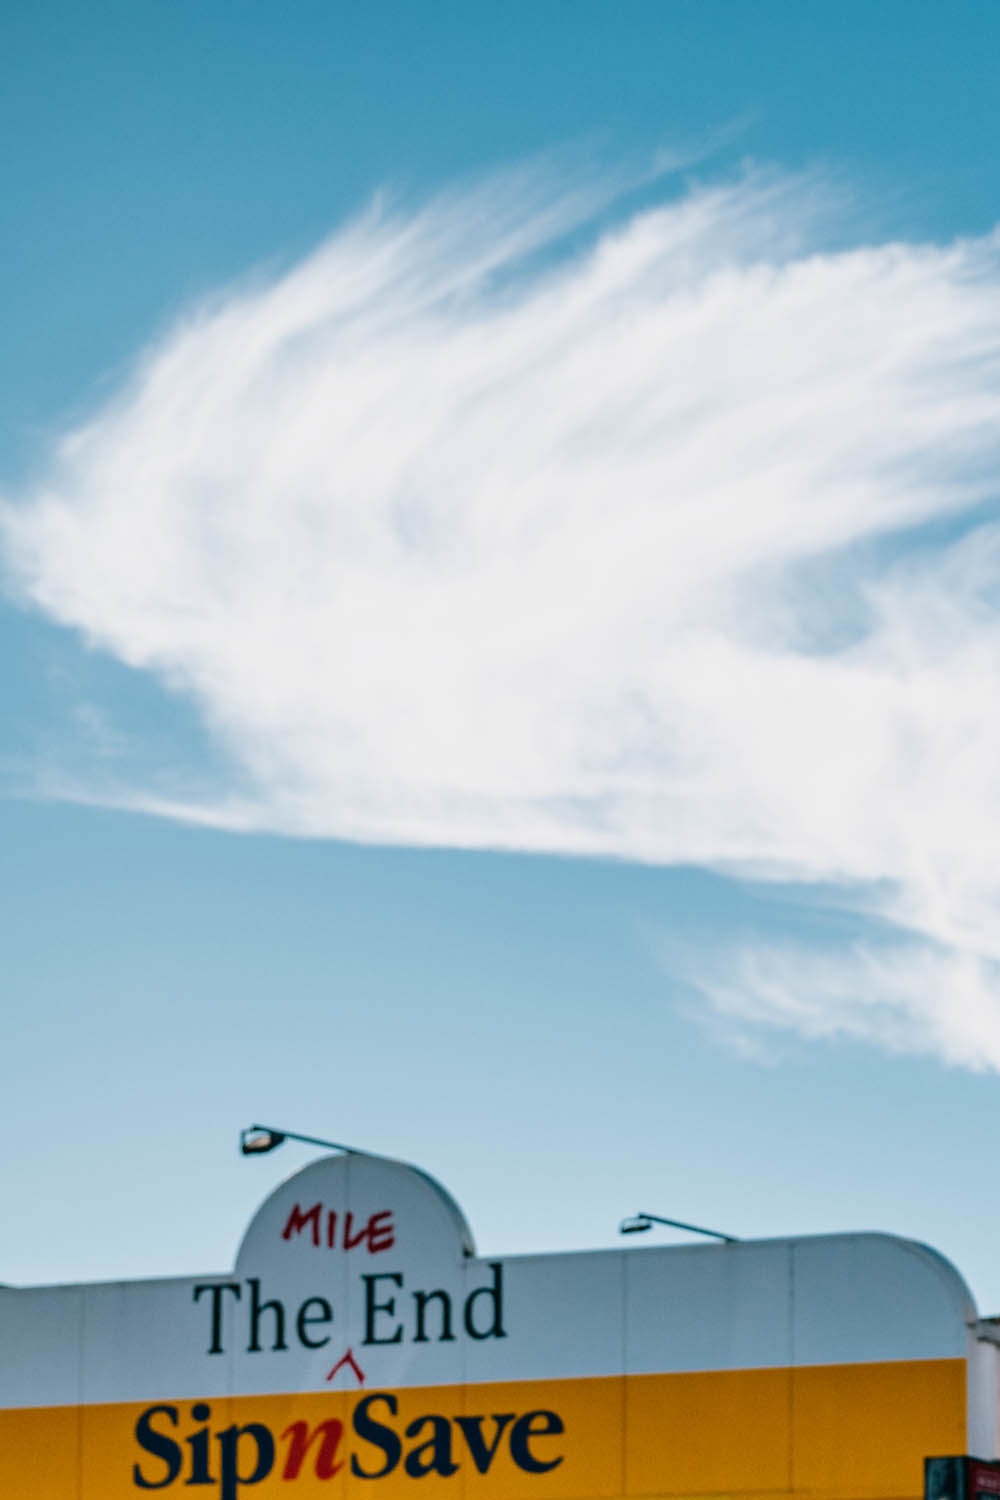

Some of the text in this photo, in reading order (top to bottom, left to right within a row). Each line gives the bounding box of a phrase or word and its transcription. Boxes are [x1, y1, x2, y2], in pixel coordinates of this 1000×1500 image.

[281, 1202, 395, 1254] MILE
[193, 1262, 508, 1355] The End
